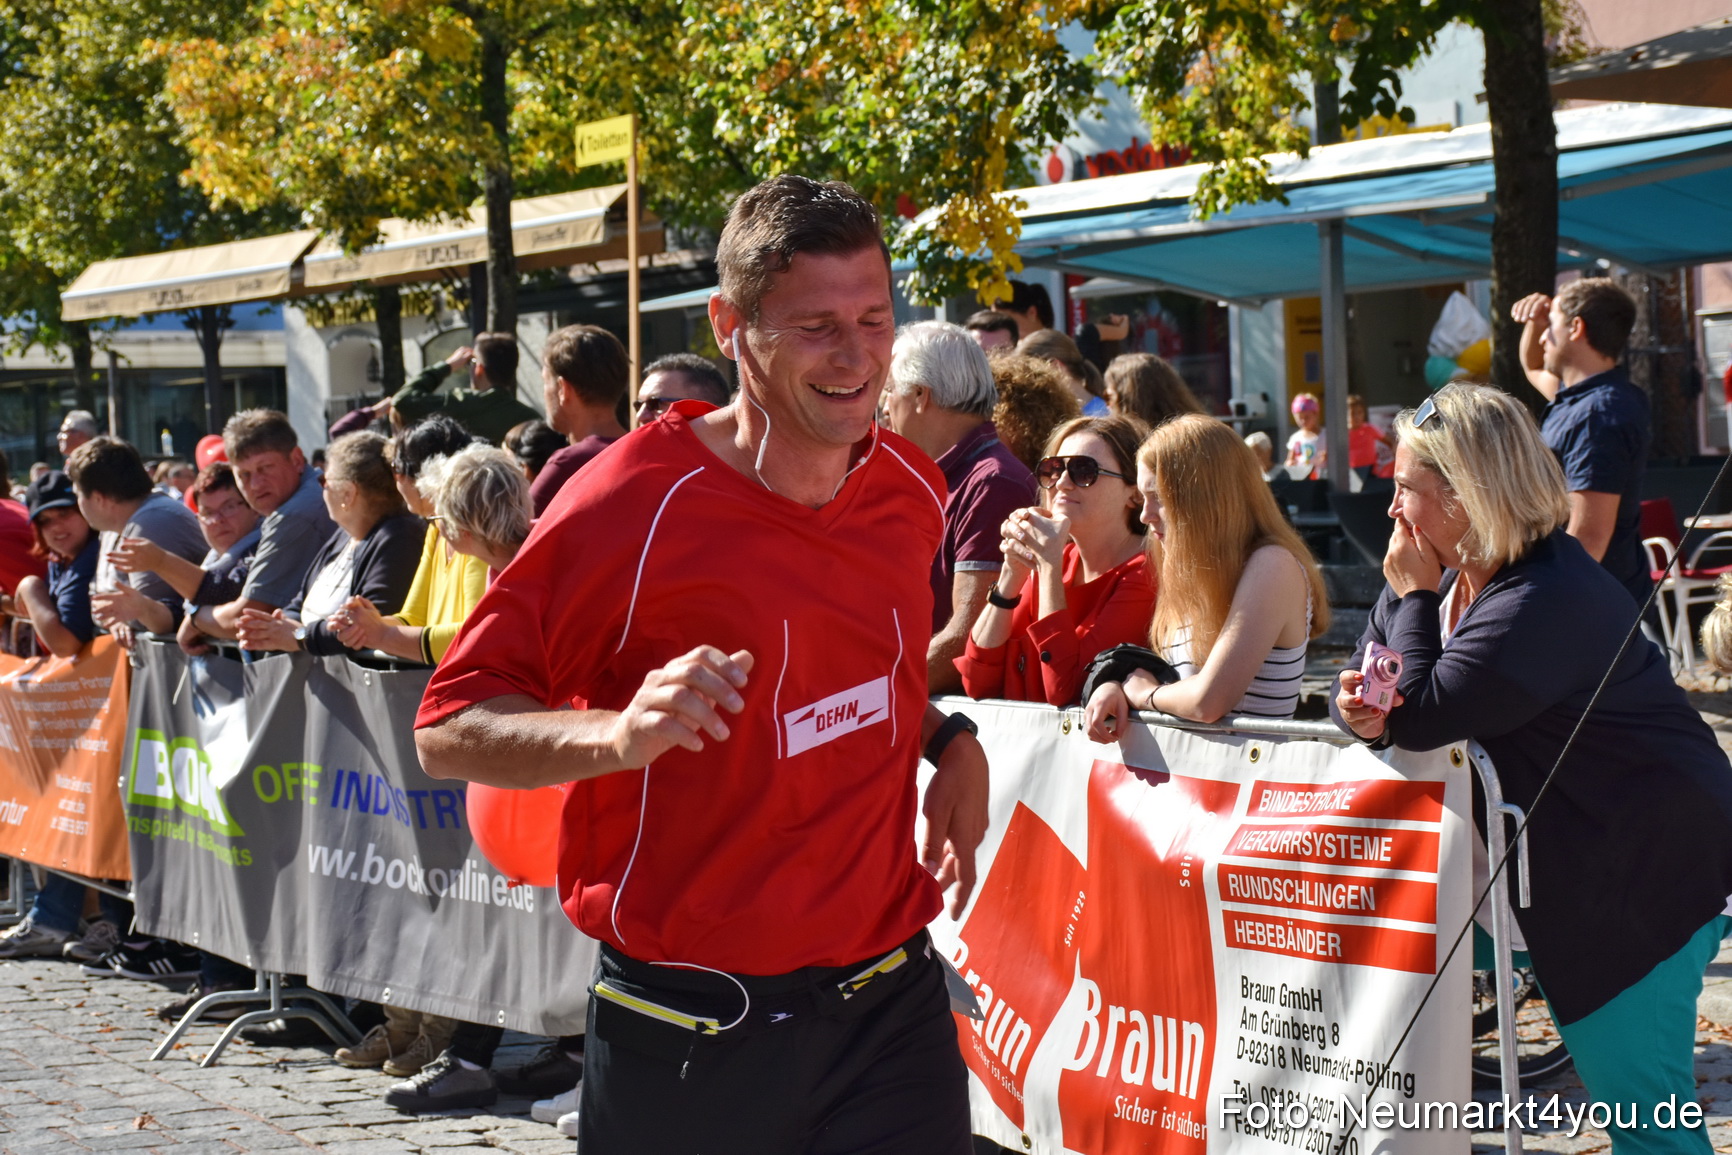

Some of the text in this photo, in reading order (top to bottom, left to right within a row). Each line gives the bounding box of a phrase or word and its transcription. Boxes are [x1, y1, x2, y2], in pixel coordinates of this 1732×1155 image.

[587, 132, 628, 152] Toiletten
[80, 677, 112, 690] Partner
[816, 699, 859, 733] DEHN
[1258, 788, 1356, 813] BINDESTRICKE
[1237, 830, 1393, 862] VERZURRSYSTEME
[1228, 873, 1376, 911] RUNDSCHLINGEN
[1064, 891, 1086, 947] Seit 1929
[1234, 919, 1342, 957] HEBEBÄNDER
[1241, 975, 1323, 1013] Braun GmbH
[1061, 977, 1205, 1100] Braun
[1240, 1006, 1340, 1050] Am Grünberg 8
[971, 1035, 991, 1069] Sicher
[990, 1061, 1001, 1080] ist
[1236, 1036, 1416, 1098] D-92318 Neumarkt-Pölling
[1114, 1095, 1207, 1140] Sicher ist sicher
